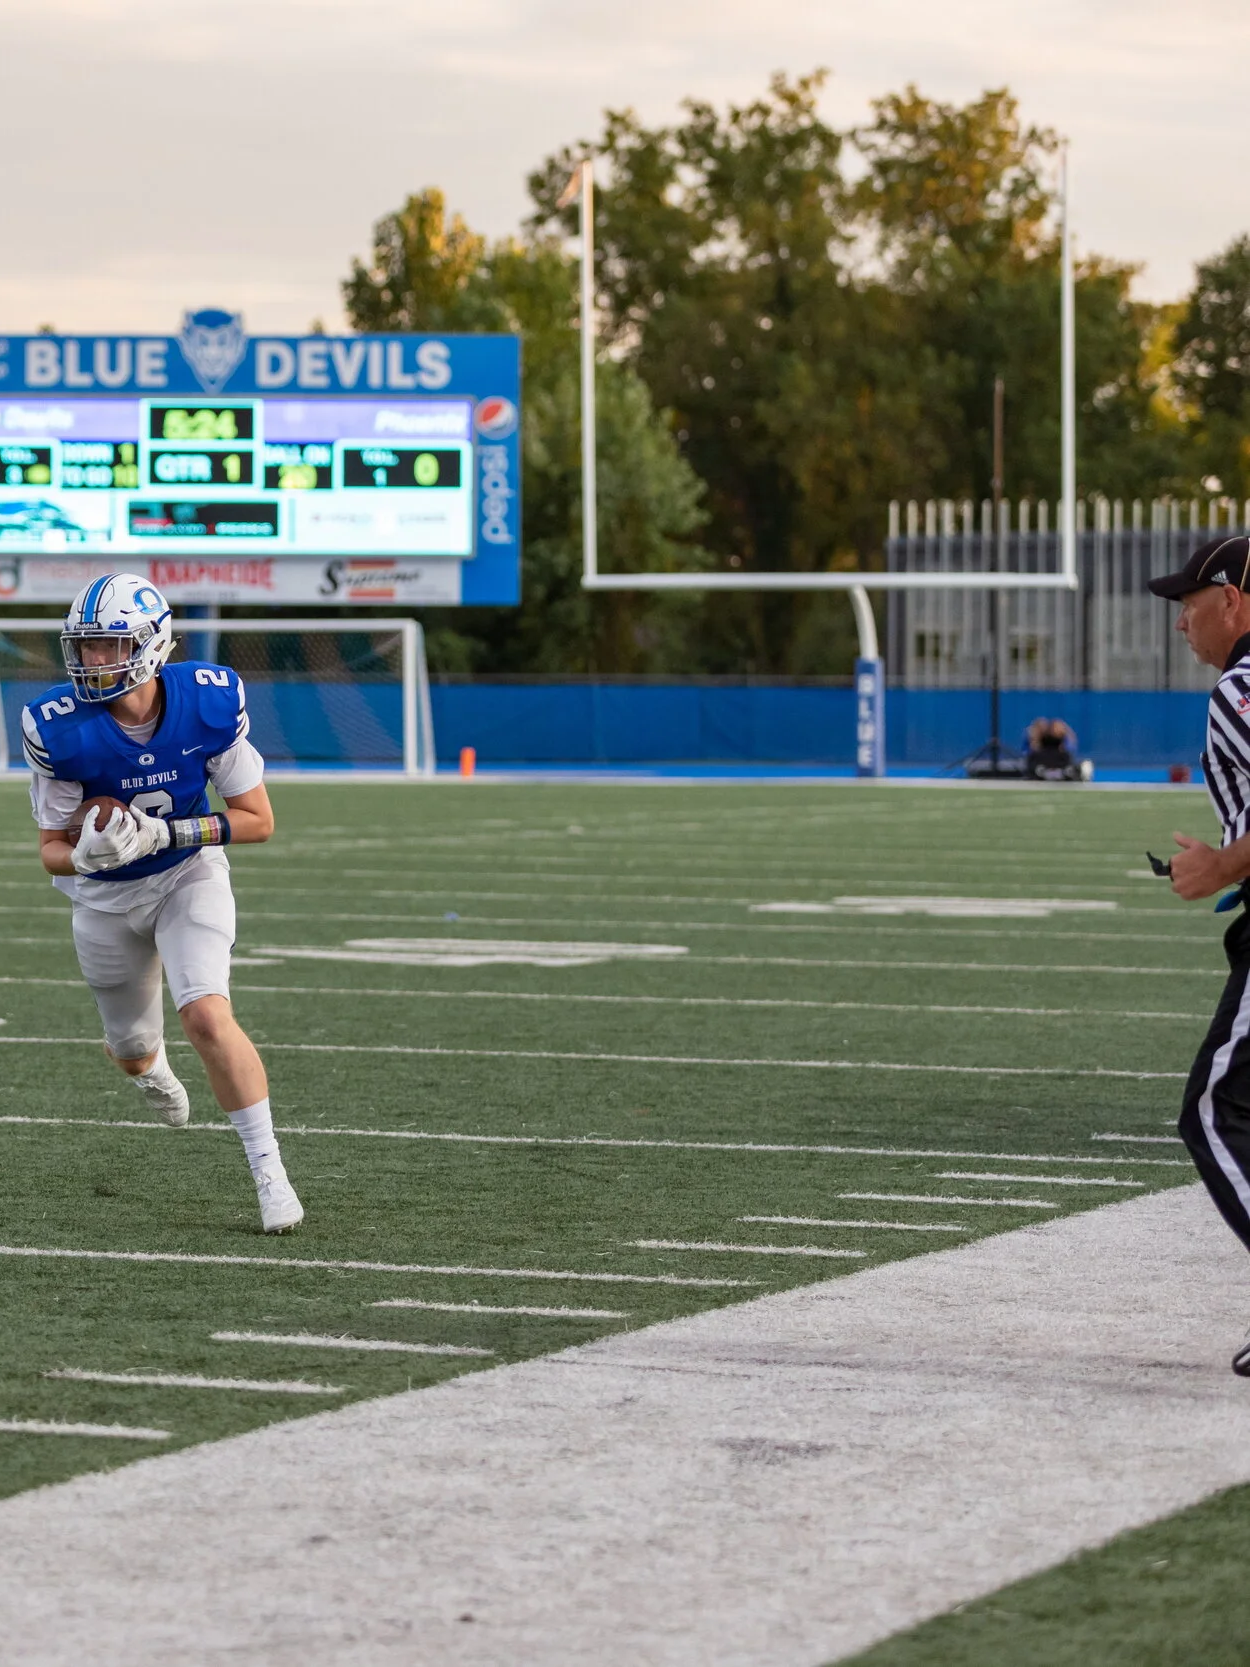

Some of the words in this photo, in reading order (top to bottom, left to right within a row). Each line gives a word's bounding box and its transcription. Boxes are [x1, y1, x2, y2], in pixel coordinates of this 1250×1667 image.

[24, 340, 169, 388] BLUE
[255, 340, 452, 389] DEVILS
[154, 453, 213, 482] QTR
[222, 453, 241, 482] 1
[413, 453, 440, 486] 0
[478, 445, 517, 544] pepsi
[133, 587, 165, 615] Q
[75, 622, 99, 630] Riddell
[196, 668, 230, 688] 2
[40, 696, 76, 721] 2
[121, 778, 144, 790] BLUE
[147, 770, 178, 786] DEVILS
